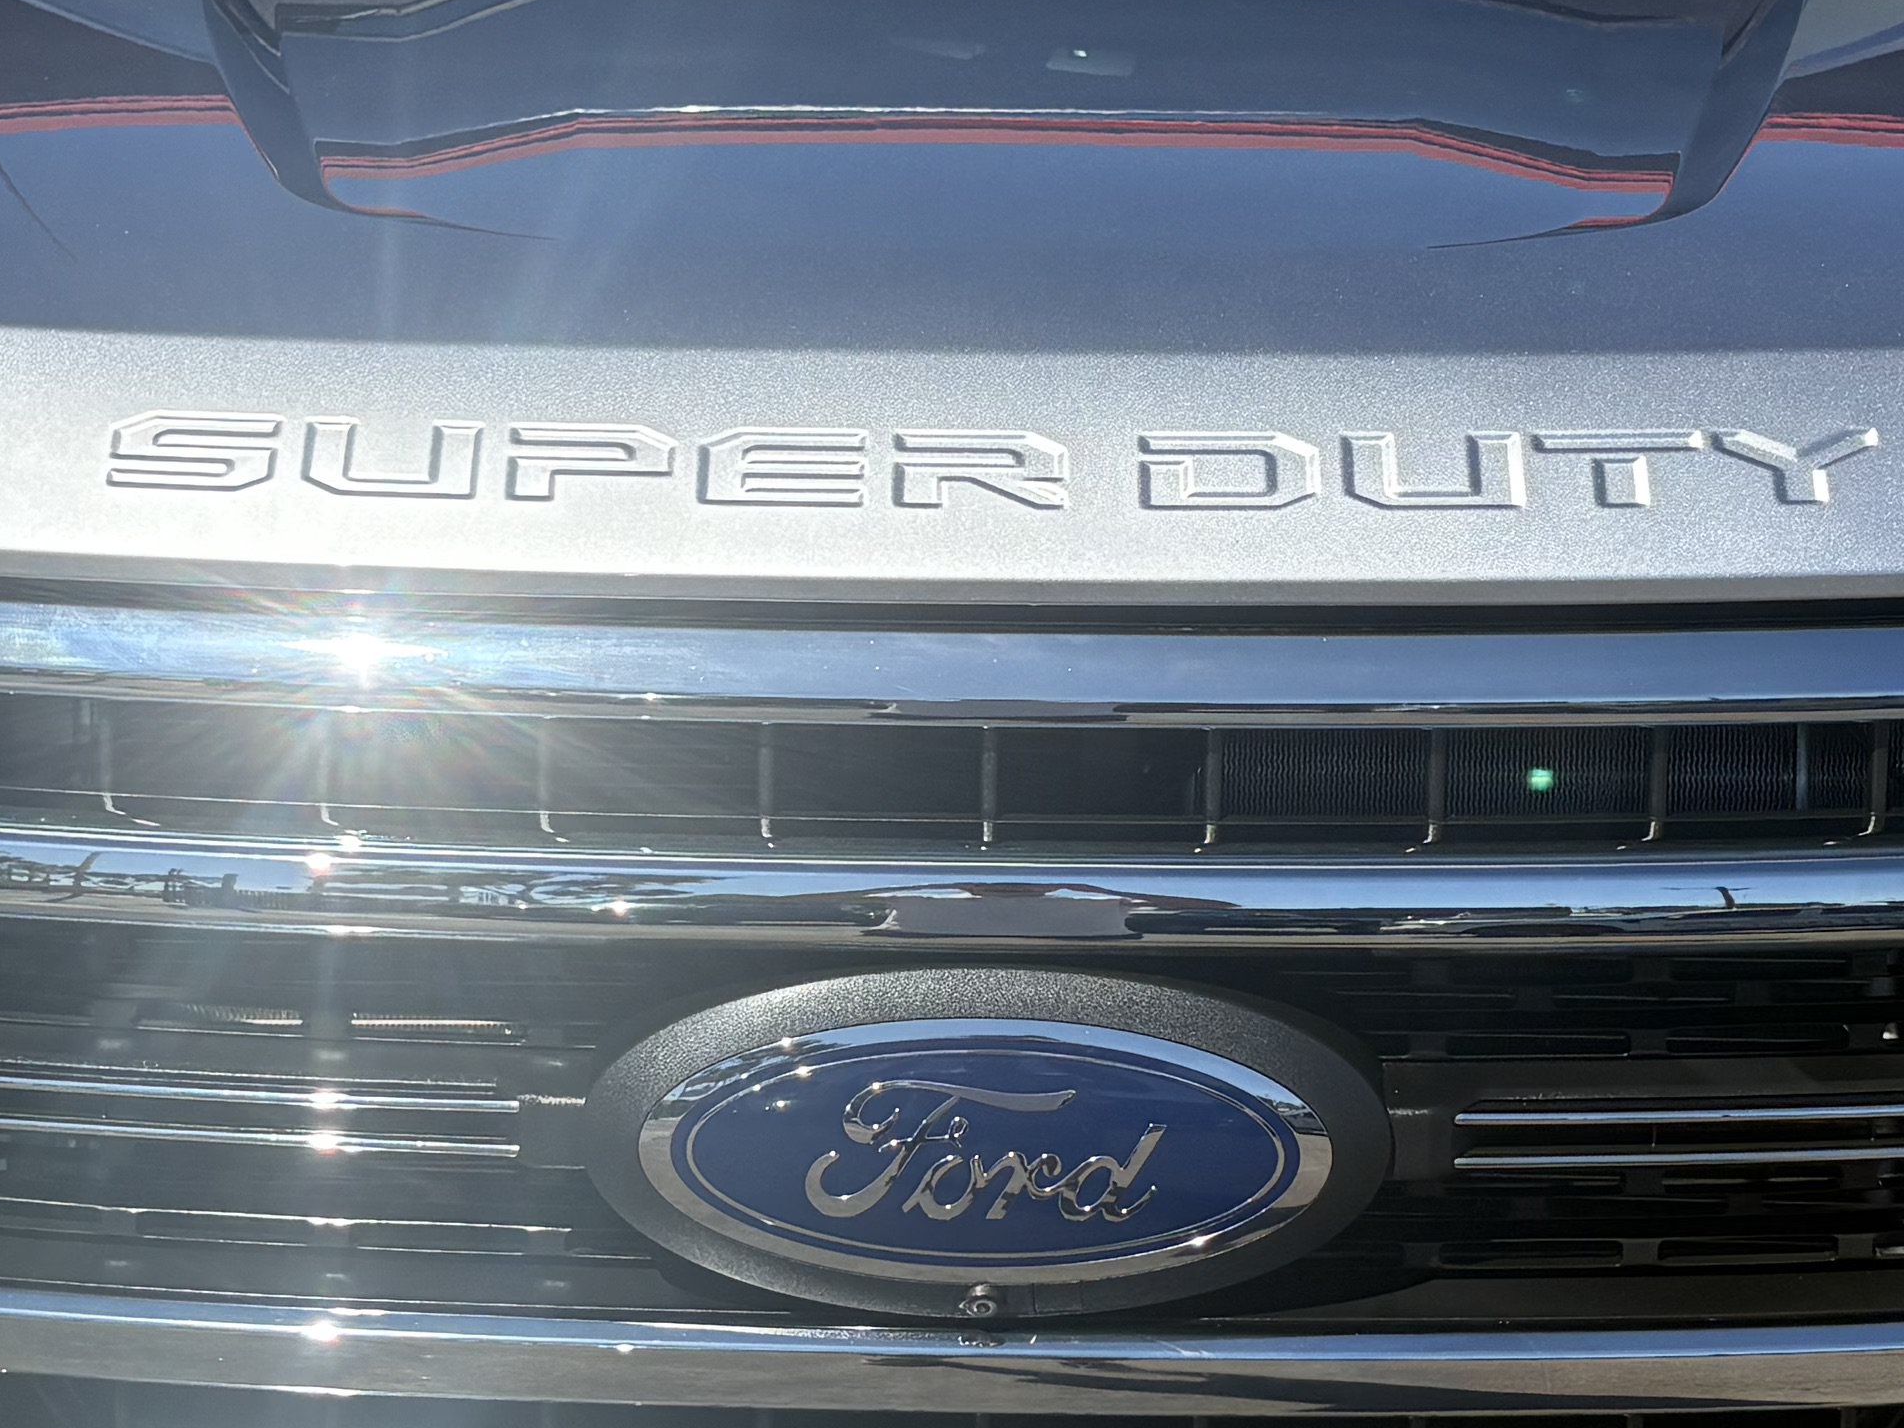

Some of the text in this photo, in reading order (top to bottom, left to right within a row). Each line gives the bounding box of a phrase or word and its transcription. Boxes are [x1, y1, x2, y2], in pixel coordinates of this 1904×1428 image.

[106, 409, 1880, 511] SUPER DUTY
[804, 1079, 1168, 1222] Ford
